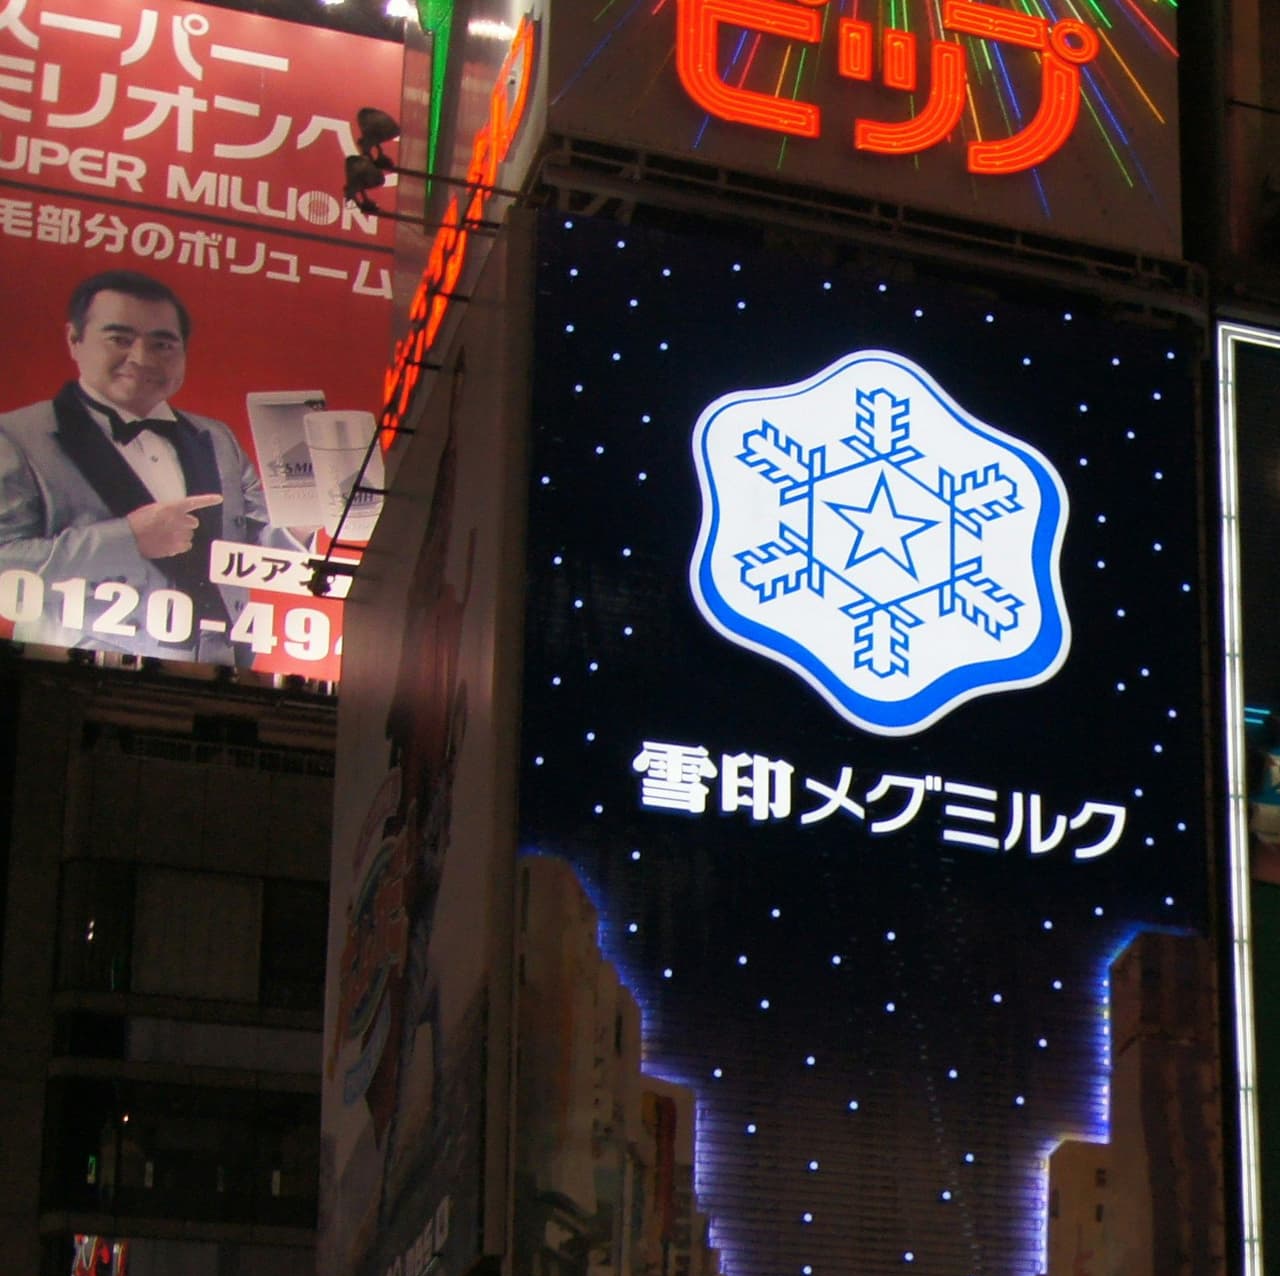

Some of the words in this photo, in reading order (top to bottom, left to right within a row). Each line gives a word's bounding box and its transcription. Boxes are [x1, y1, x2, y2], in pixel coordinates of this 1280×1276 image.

[166, 164, 378, 235] MILLION
[221, 552, 332, 587] ルア
[0, 567, 343, 662] 0120-49
[632, 740, 1127, 859] 雪印メグミルク
